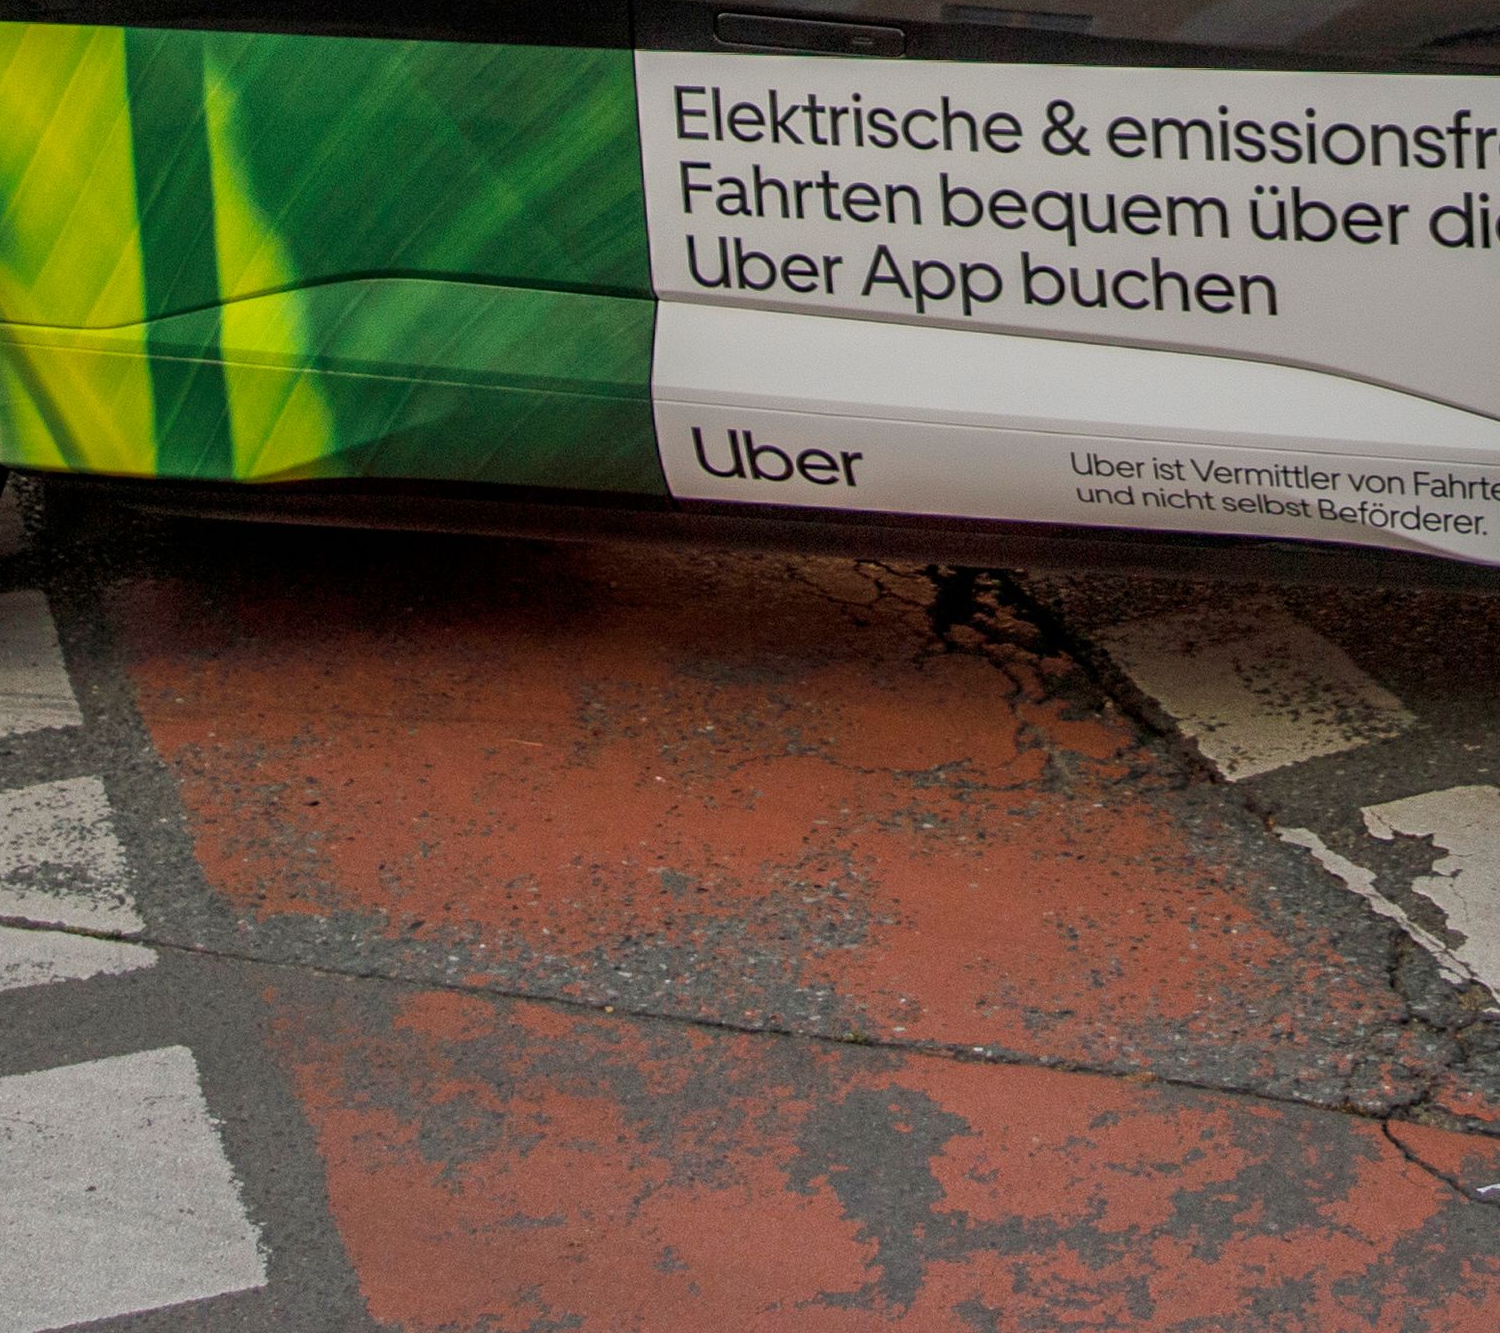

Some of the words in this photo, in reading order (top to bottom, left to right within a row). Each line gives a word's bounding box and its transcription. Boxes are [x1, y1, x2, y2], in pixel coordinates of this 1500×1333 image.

[673, 85, 1024, 157] Elektrische
[1041, 99, 1092, 157] &
[679, 160, 924, 227] Fahrten
[939, 172, 1231, 249] bequem
[1249, 184, 1411, 247] über
[686, 234, 844, 296] Uber
[861, 244, 1005, 317] App
[1020, 251, 1279, 318] buchen
[691, 426, 864, 487] Uber
[1070, 451, 1145, 479] Uber
[1153, 458, 1186, 482] ist
[1189, 458, 1342, 491] Vermittler
[1348, 473, 1406, 496] von
[1076, 487, 1135, 507] und
[1141, 488, 1216, 512] nicht
[1222, 493, 1312, 519] selbst
[1318, 497, 1488, 536] Beförderer.
